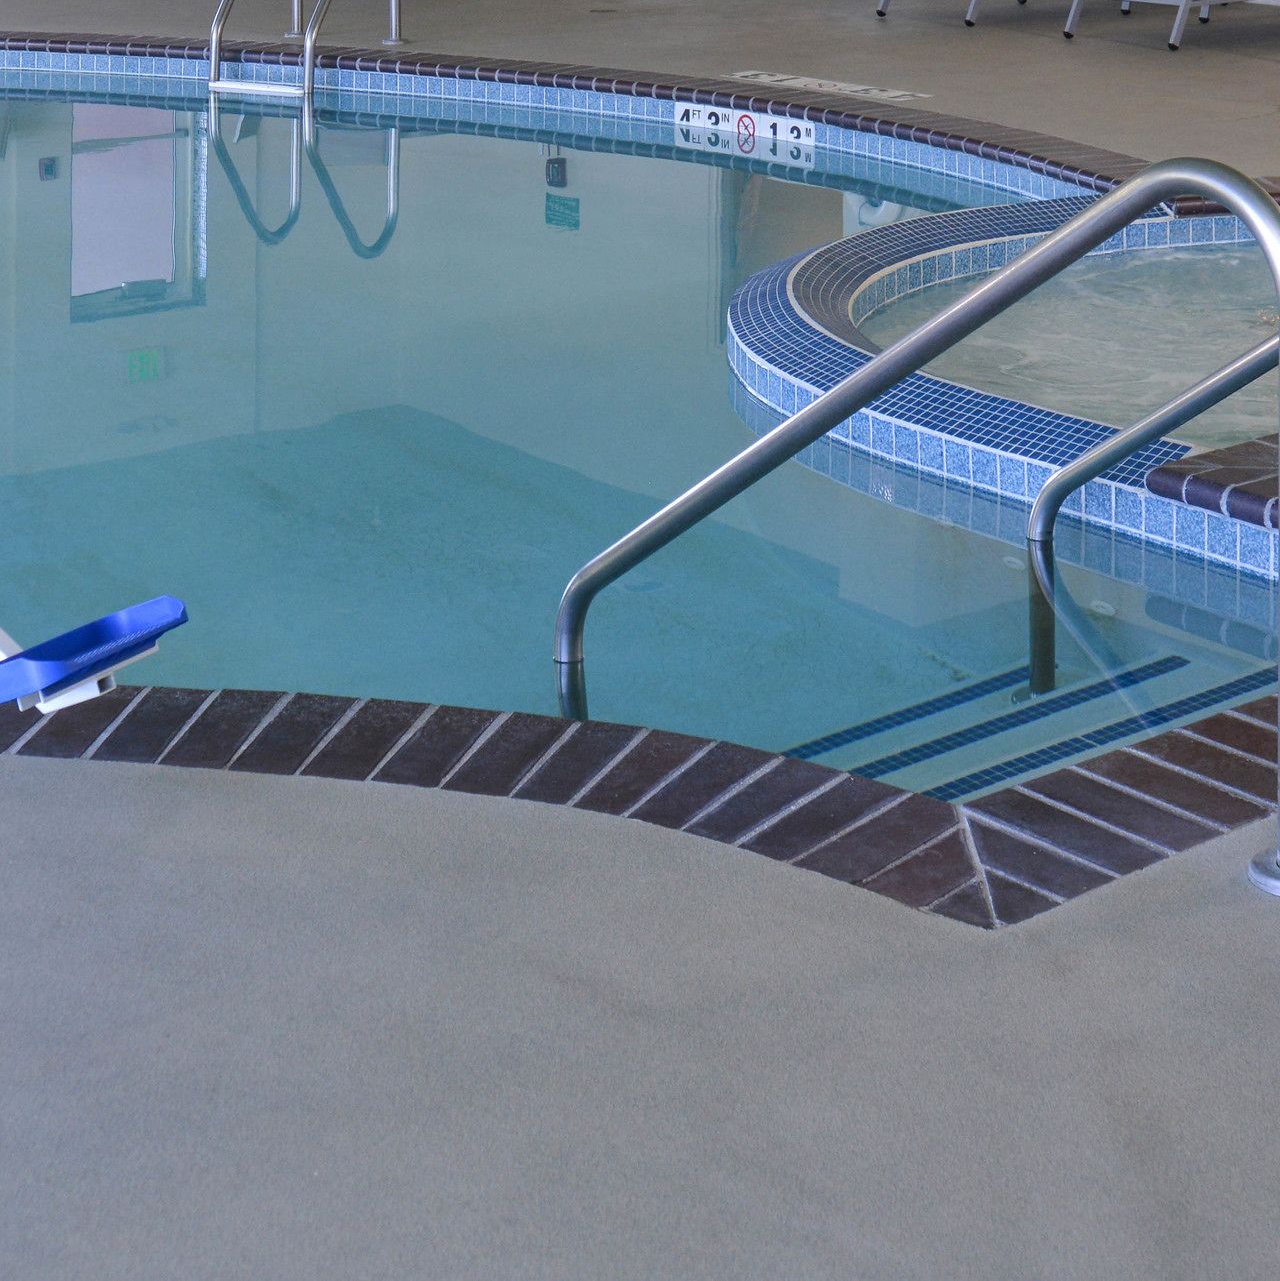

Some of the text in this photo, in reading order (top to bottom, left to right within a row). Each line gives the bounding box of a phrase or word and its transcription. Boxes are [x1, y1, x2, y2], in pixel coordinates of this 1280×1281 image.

[692, 110, 701, 120] FT
[721, 113, 730, 123] IN
[805, 127, 812, 138] M
